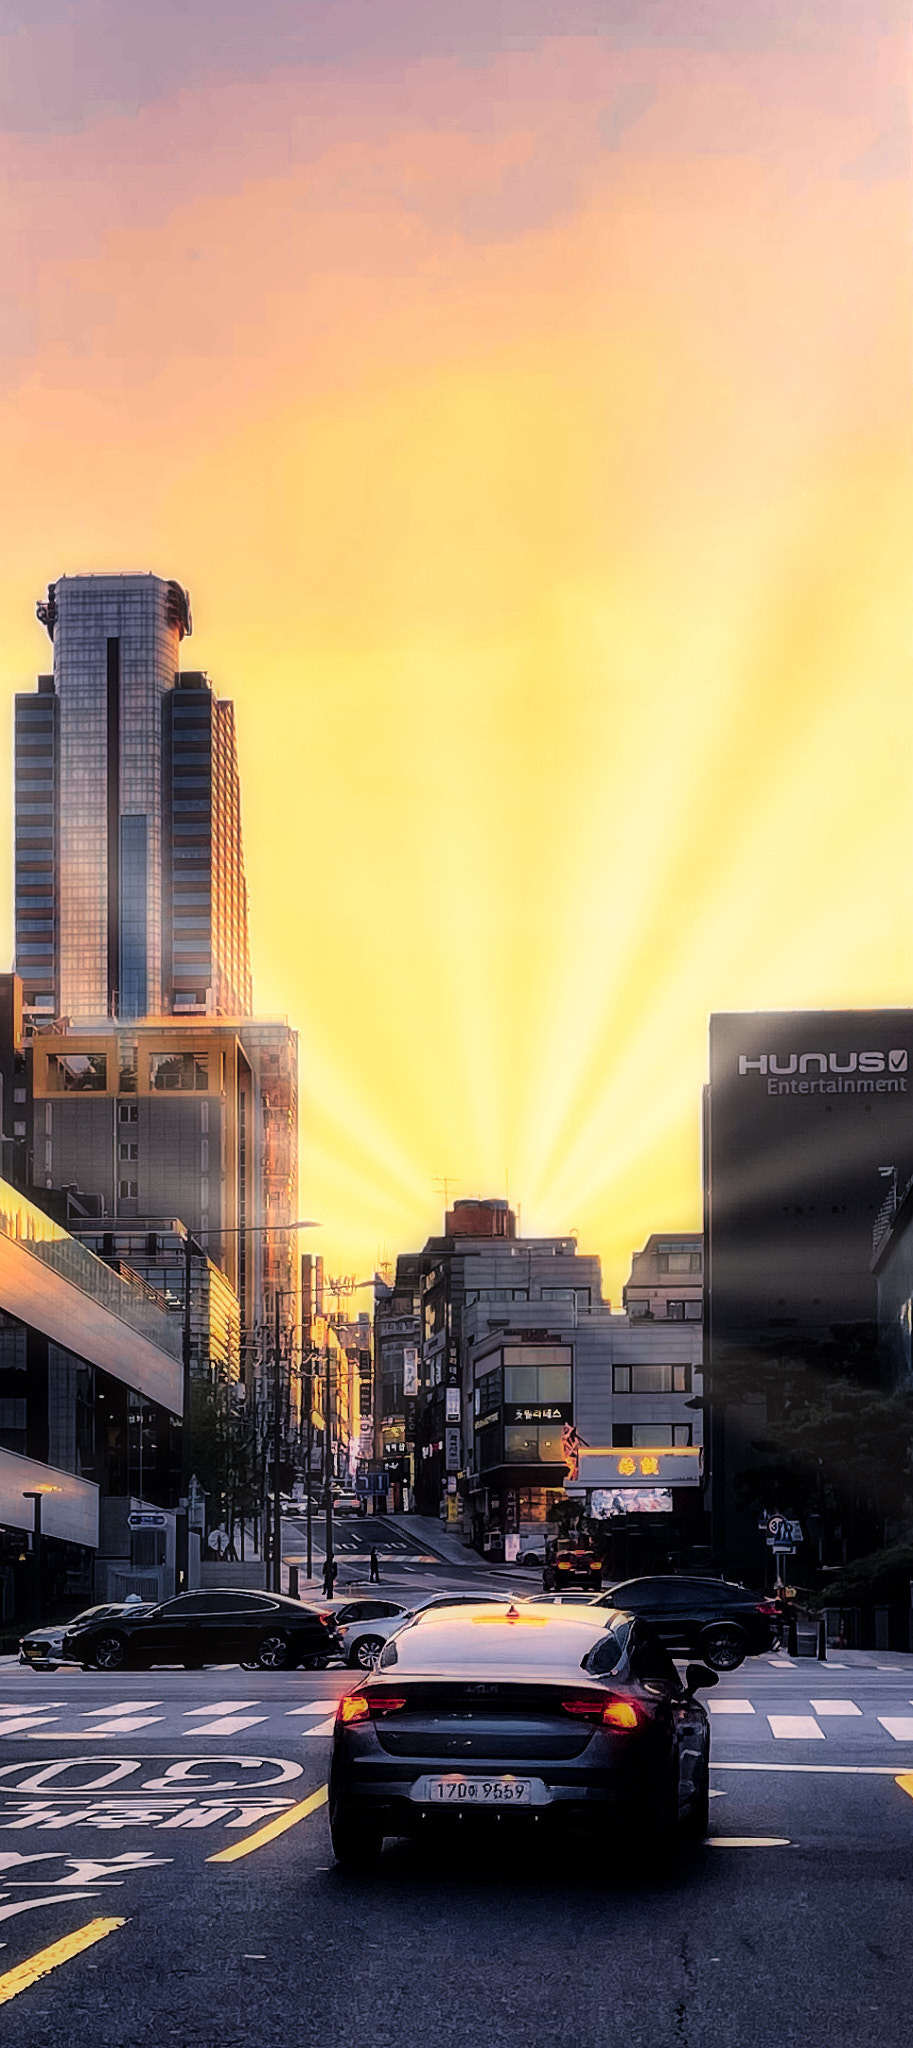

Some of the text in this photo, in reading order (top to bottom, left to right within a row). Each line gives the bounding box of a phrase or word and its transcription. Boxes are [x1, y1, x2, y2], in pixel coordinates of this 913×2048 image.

[738, 1052, 885, 1075] HUNUS
[768, 1077, 907, 1094] Entertainment
[16, 1758, 264, 1791] 30
